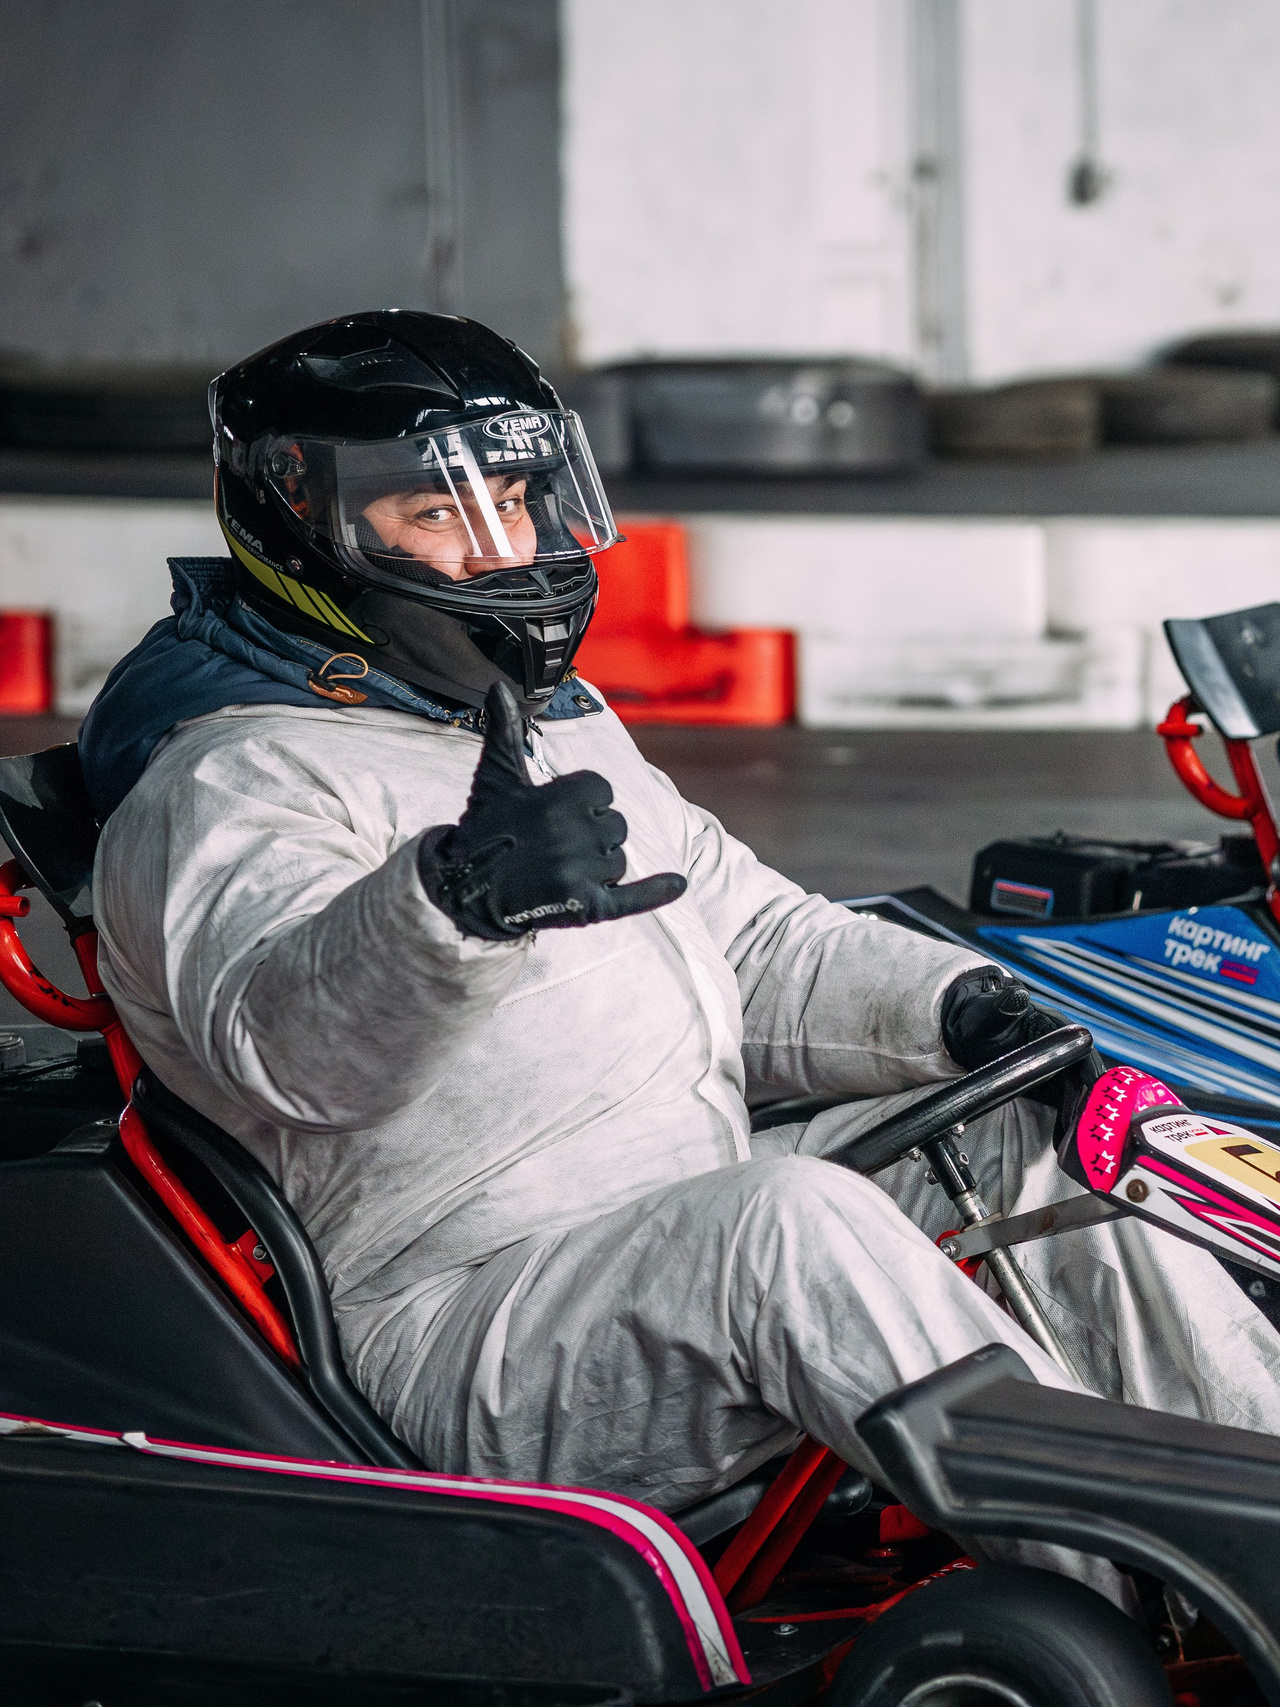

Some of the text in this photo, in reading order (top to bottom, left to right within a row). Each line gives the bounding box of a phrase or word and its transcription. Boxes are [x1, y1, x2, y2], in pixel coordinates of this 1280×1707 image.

[497, 416, 543, 434] YEMA
[1167, 915, 1271, 962] картинг
[1164, 938, 1222, 974] трек
[1164, 1130, 1195, 1144] трек
